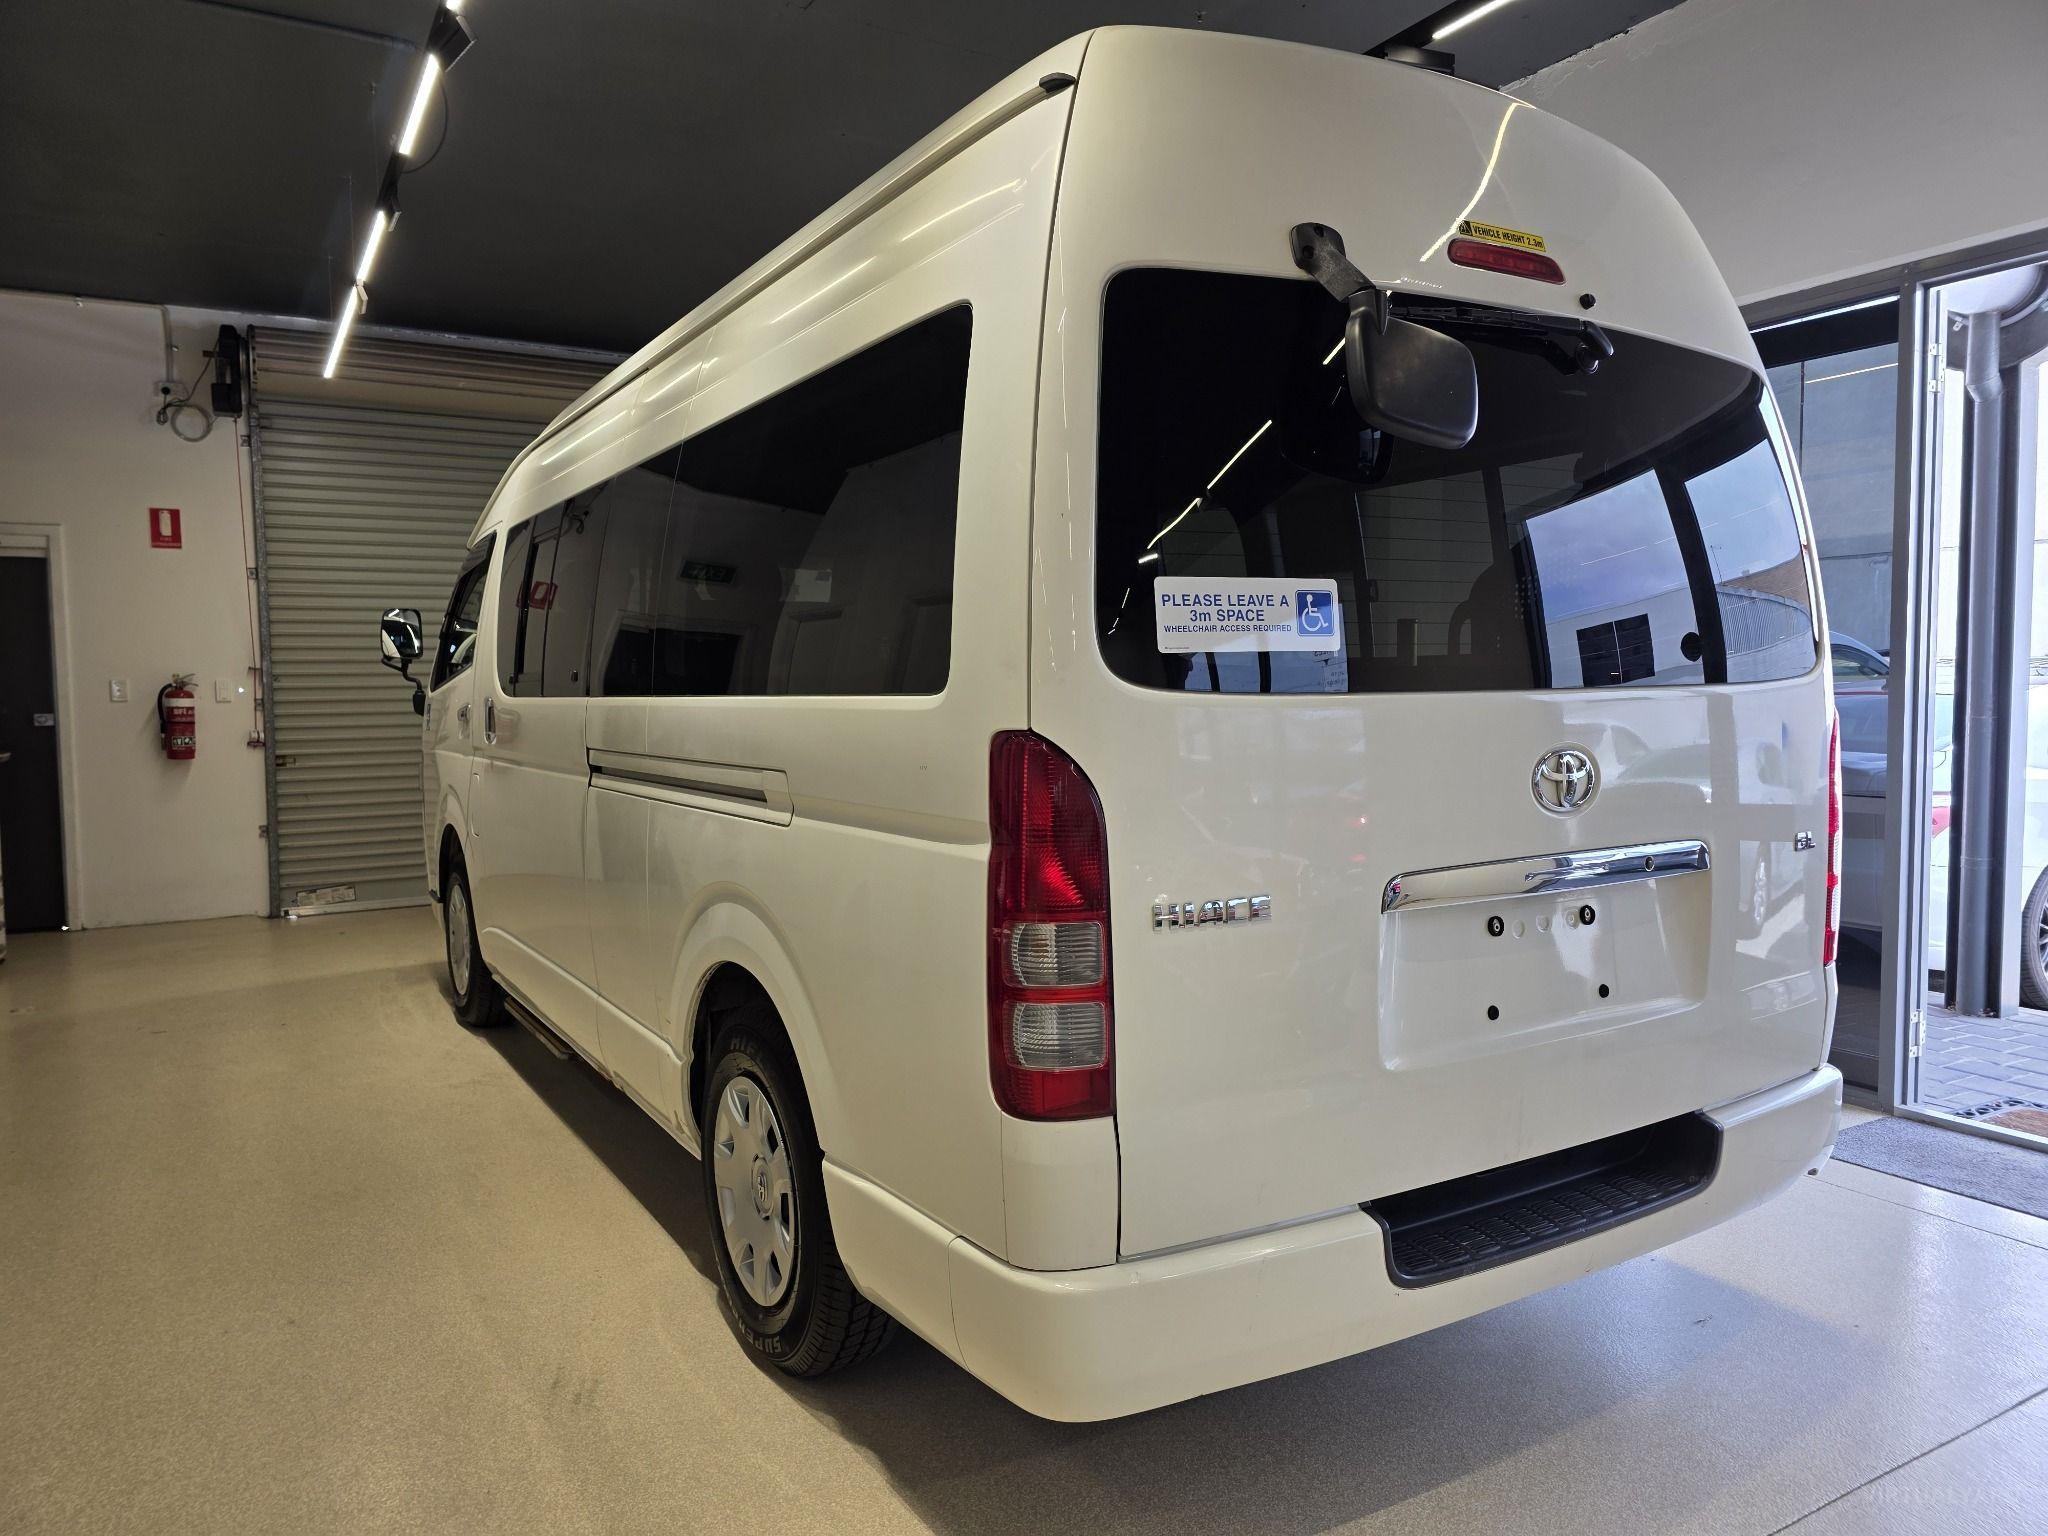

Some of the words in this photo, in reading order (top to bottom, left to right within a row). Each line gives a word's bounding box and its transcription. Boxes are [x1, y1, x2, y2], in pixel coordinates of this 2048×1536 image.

[1472, 225, 1501, 240] VEHICLE
[1526, 236, 1543, 249] 2.3m
[1161, 593, 1226, 607] PLEASE
[1227, 594, 1275, 607] LEAVE
[1279, 594, 1290, 607] A
[1189, 609, 1212, 622] 3m
[1216, 609, 1265, 622] SPACE
[1163, 624, 1218, 633] WHEELCHAIR
[1219, 624, 1251, 633] ACCESS
[1252, 624, 1292, 633] REQUIRED
[1152, 895, 1272, 931] HIACE
